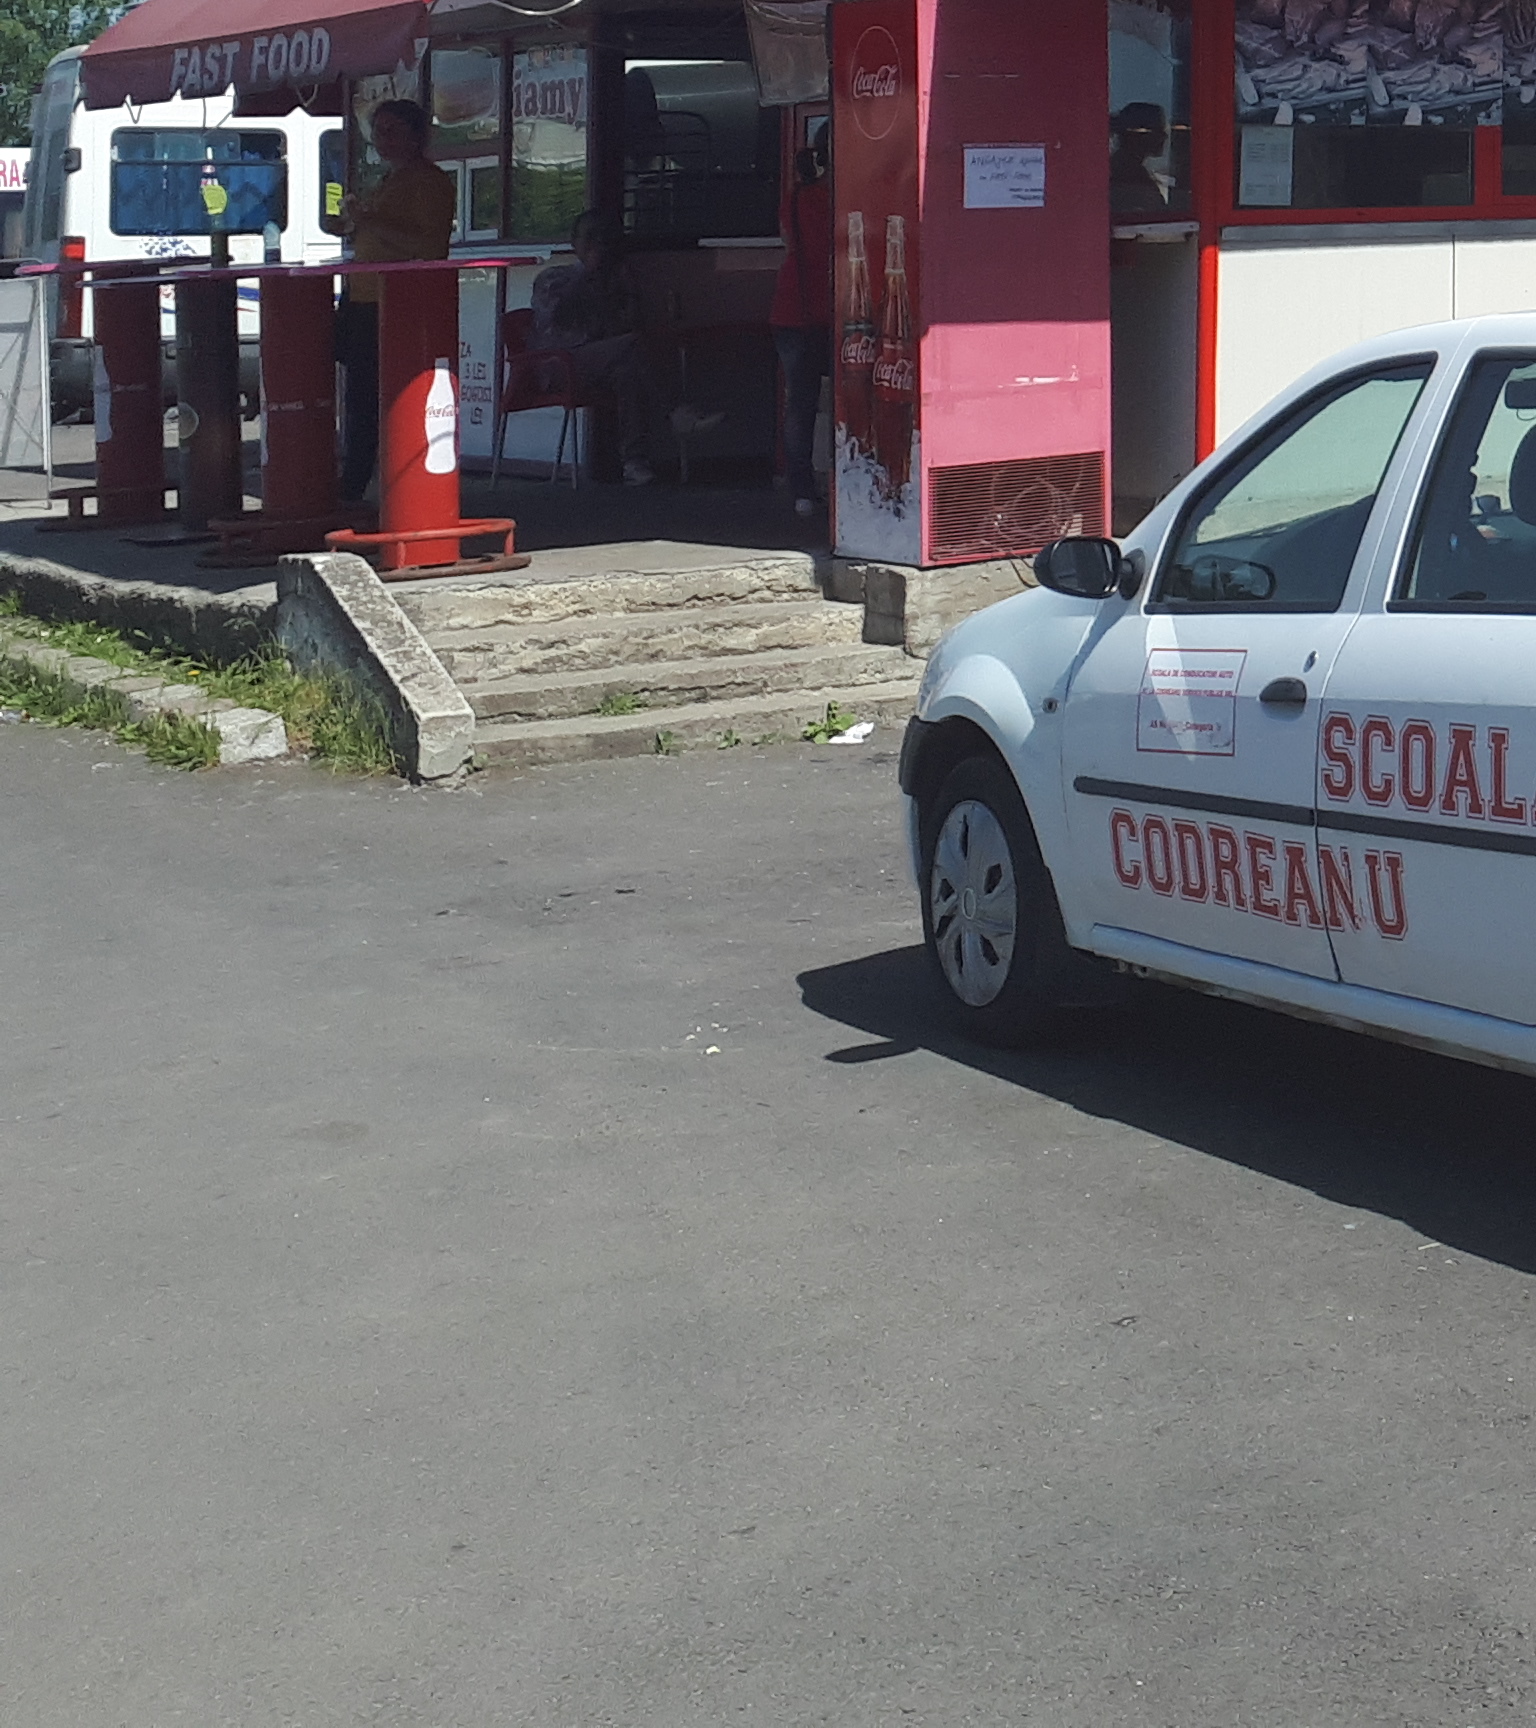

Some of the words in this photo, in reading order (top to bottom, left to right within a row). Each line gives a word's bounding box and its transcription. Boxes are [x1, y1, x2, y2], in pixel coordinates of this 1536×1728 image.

[169, 40, 240, 93] FAST
[251, 26, 330, 84] FOOD
[1108, 807, 1409, 940] CODREANU
